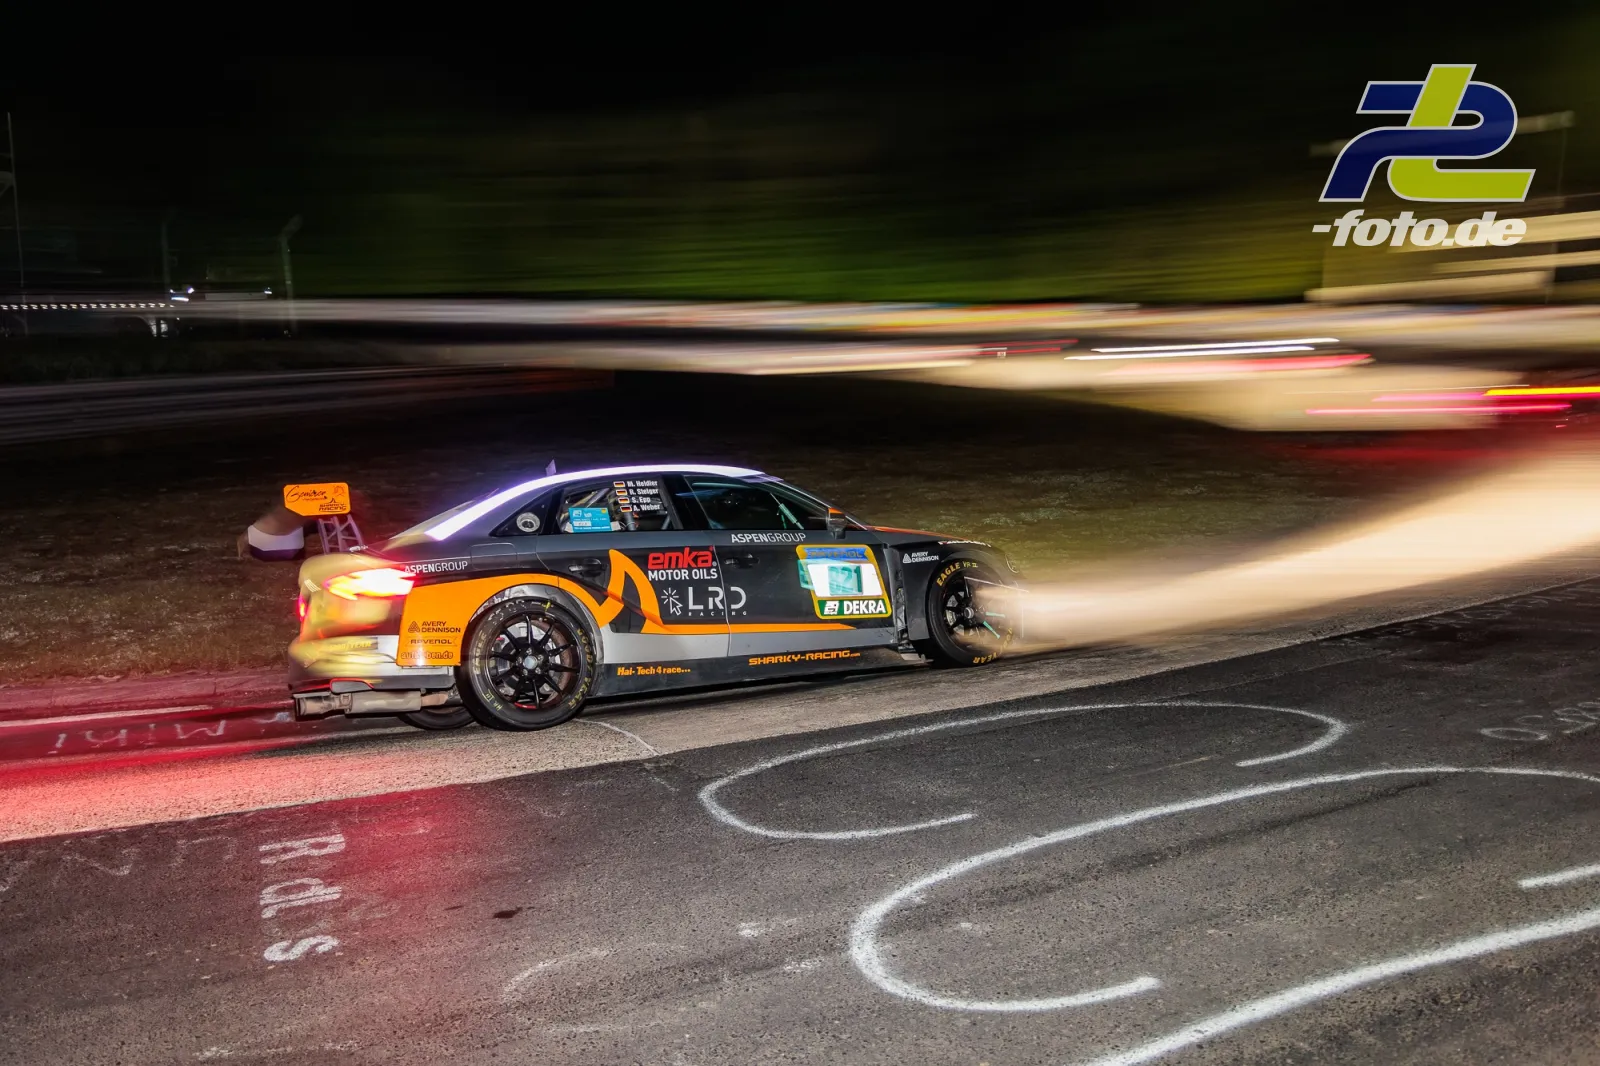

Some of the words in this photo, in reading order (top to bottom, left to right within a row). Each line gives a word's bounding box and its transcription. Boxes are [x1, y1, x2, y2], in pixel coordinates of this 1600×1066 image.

[731, 532, 807, 544] ASPENGROUP
[647, 546, 714, 569] emka
[404, 560, 469, 574] ASPENGROUP
[648, 569, 690, 581] MOTOR
[692, 568, 719, 580] OILS
[936, 562, 961, 587] EAGLE
[843, 600, 887, 615] DEKRA
[656, 666, 662, 674] 4
